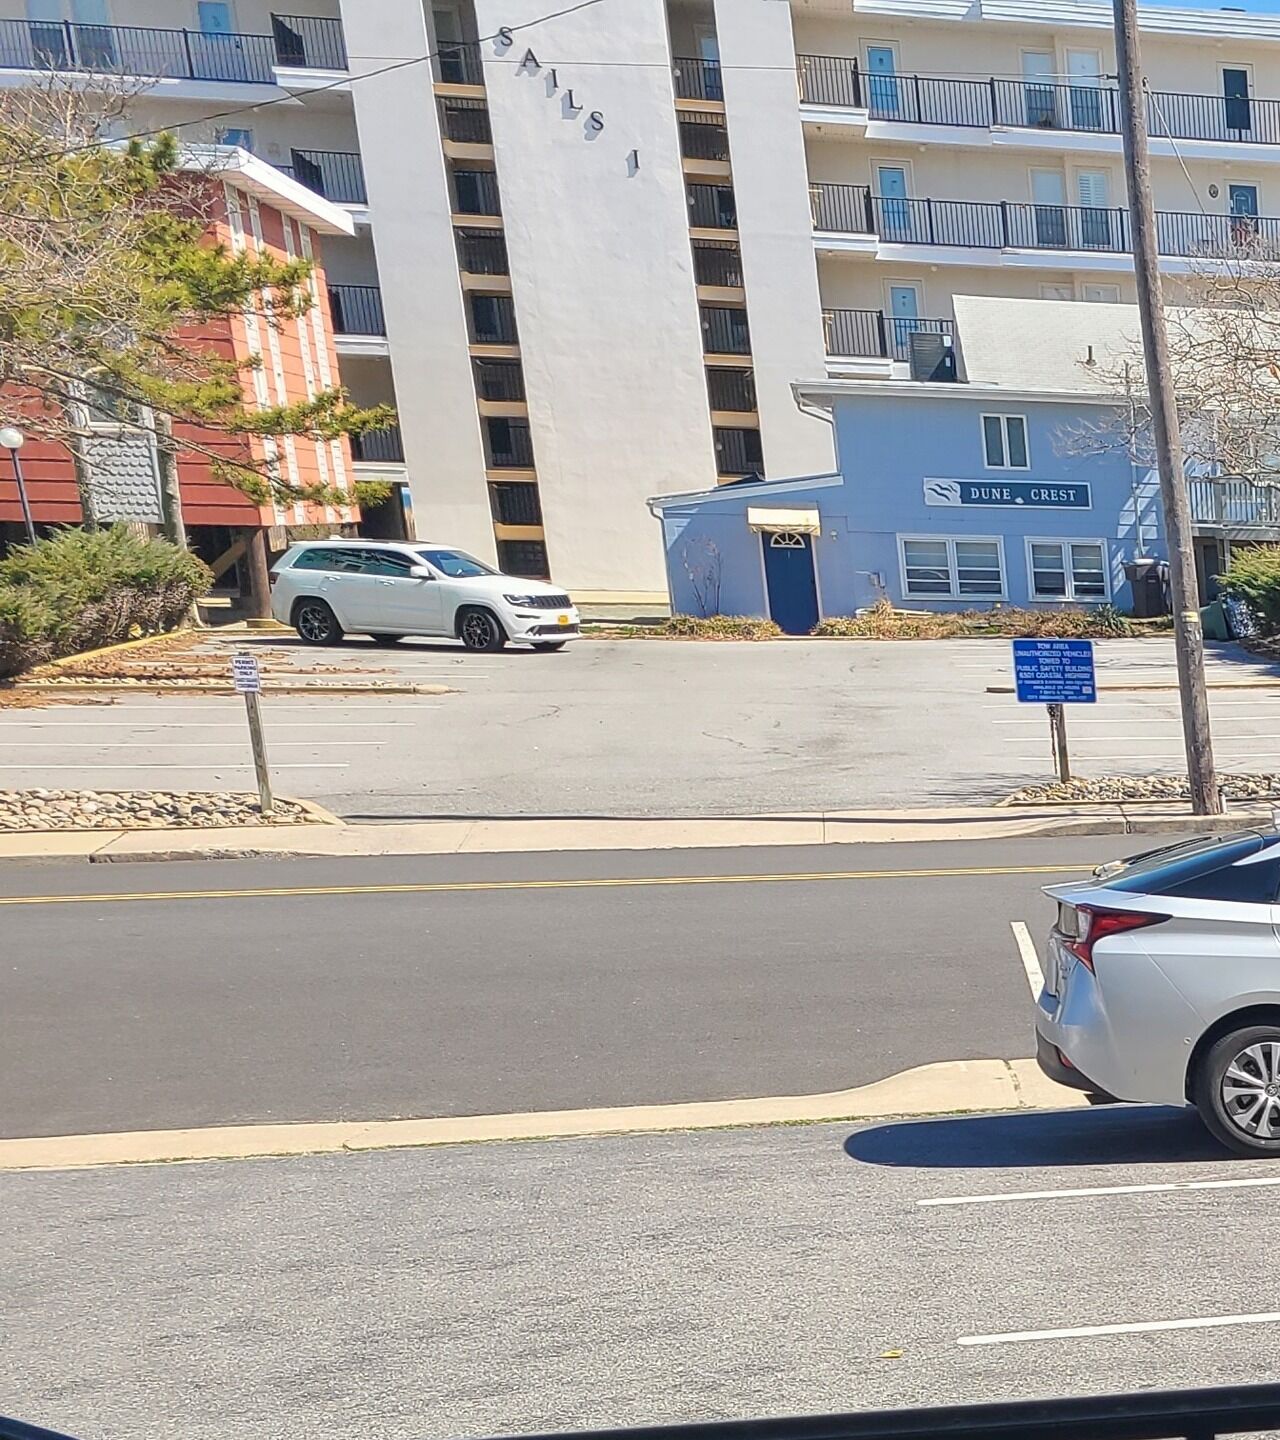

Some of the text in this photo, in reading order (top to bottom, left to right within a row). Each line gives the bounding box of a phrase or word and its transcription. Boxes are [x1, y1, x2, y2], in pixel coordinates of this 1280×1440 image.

[499, 26, 640, 169] SAILS I
[970, 487, 1076, 501] DUNE CREST
